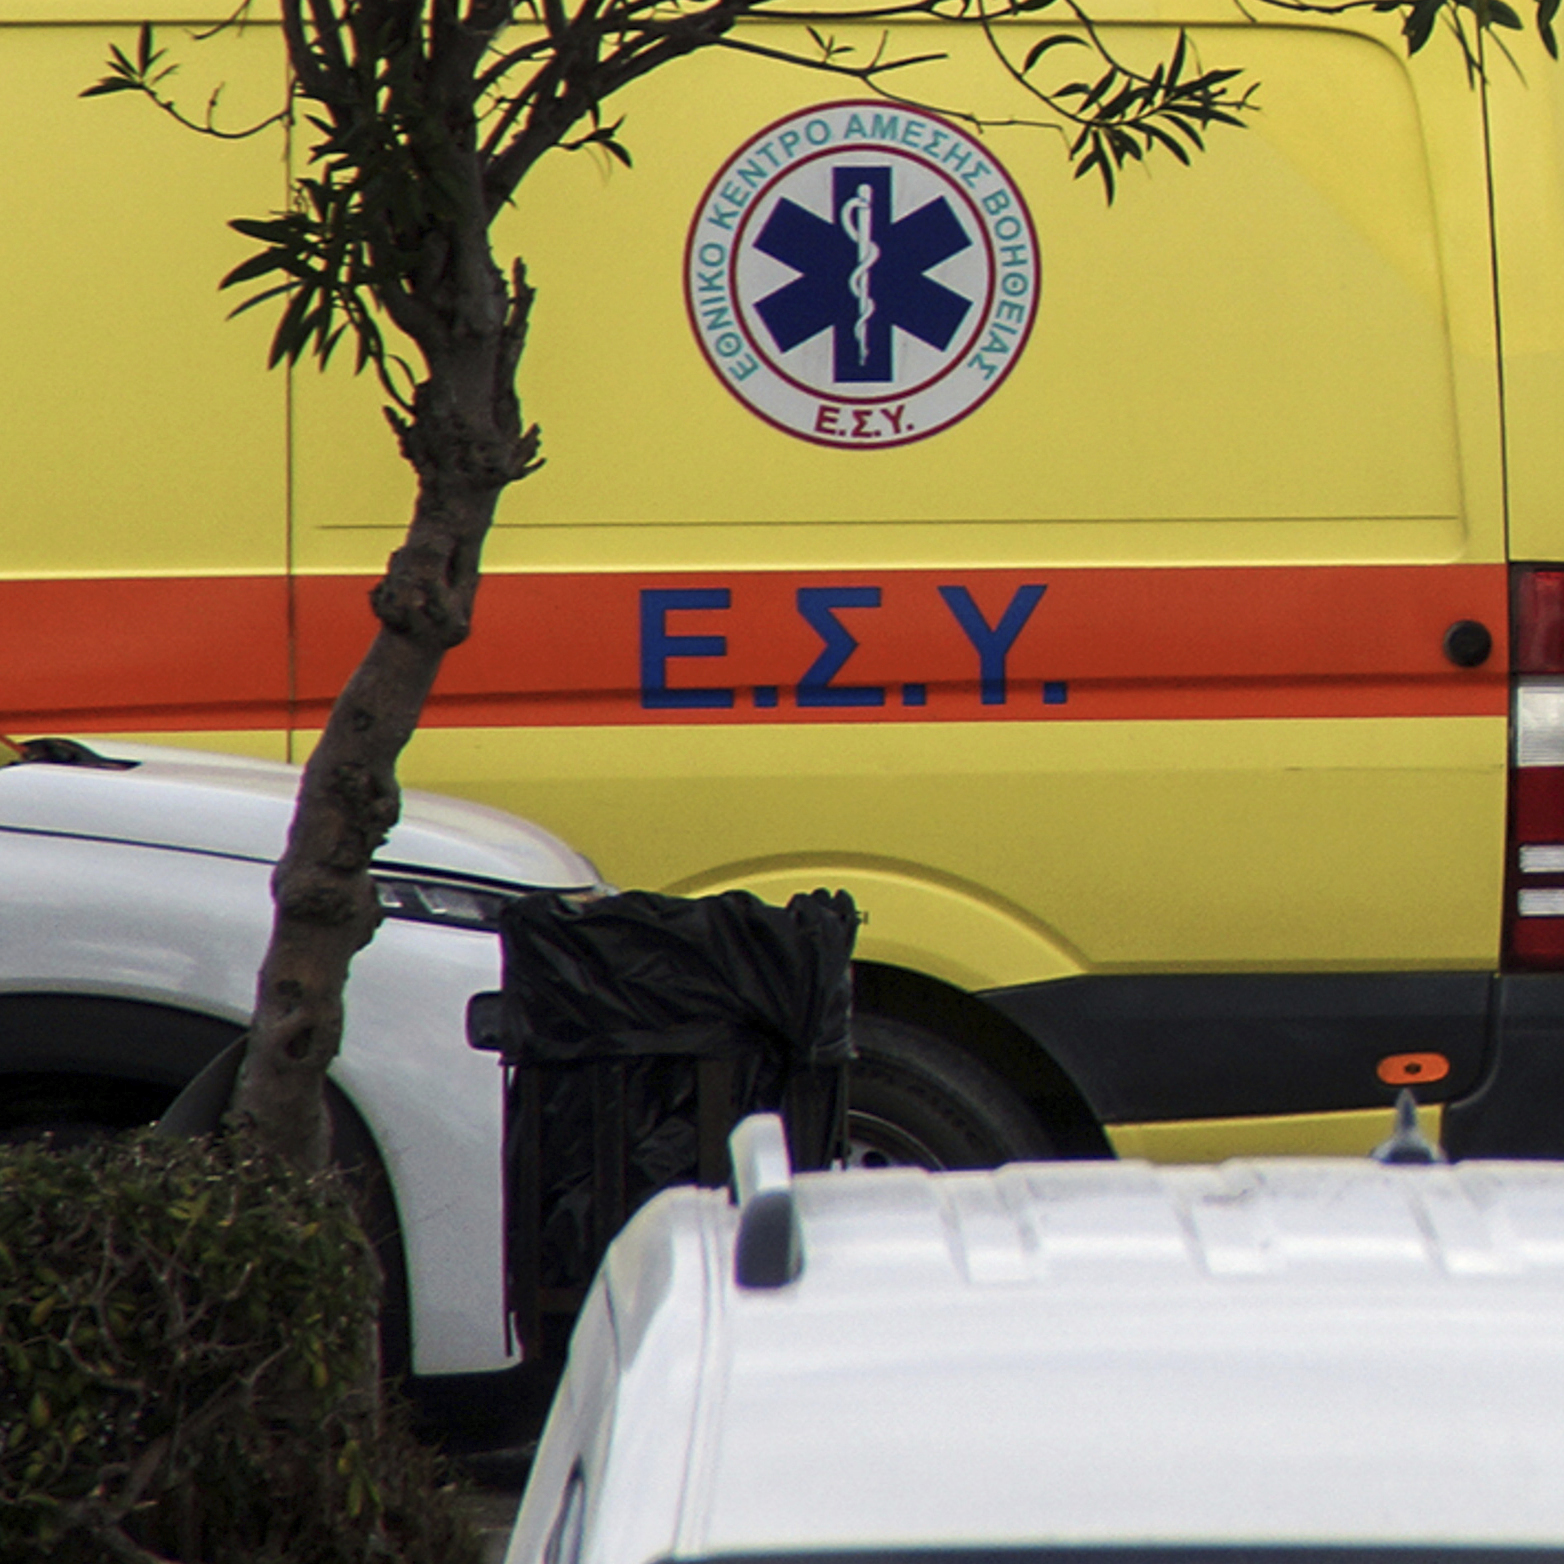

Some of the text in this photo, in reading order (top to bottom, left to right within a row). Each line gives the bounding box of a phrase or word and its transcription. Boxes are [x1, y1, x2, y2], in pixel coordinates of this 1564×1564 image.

[698, 112, 1031, 383] ΕΘΝΙΚΟ ΚΕΝΤΡΟ ΑΜΕΣΗΣ ΒΟΗΘΕΙΑΣ
[814, 403, 916, 440] Ε.Σ.Υ.
[639, 584, 1070, 710] Ε.Σ.Υ.
